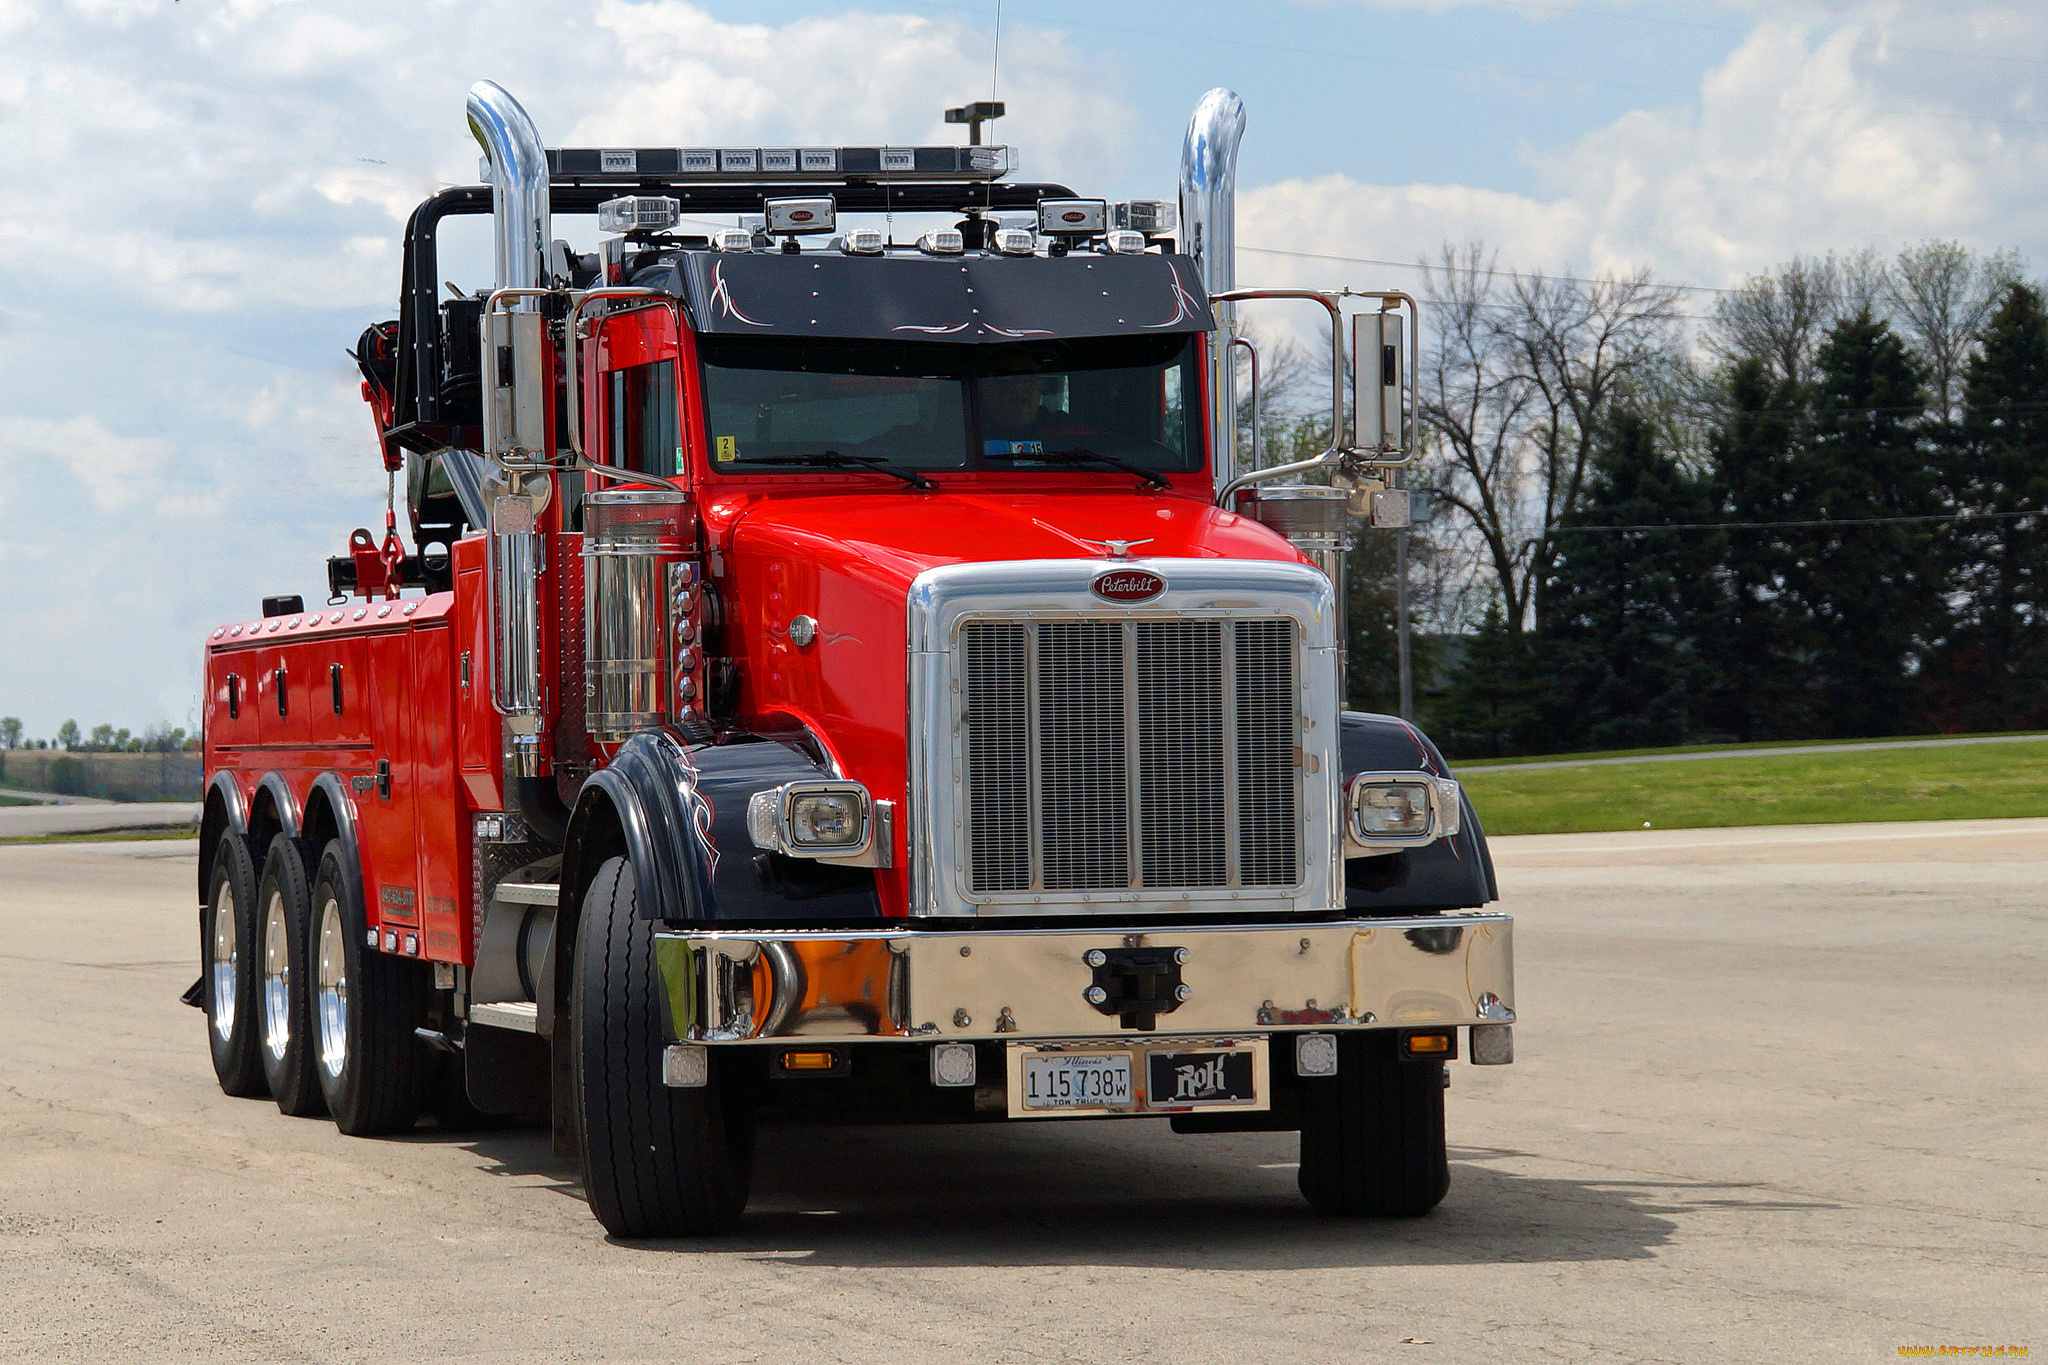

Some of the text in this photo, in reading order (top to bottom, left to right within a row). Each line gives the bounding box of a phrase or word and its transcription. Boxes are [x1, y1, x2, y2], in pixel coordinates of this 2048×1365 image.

[722, 438, 729, 450] 2
[1101, 576, 1158, 594] Peterbilt
[1062, 1056, 1102, 1067] Illinois
